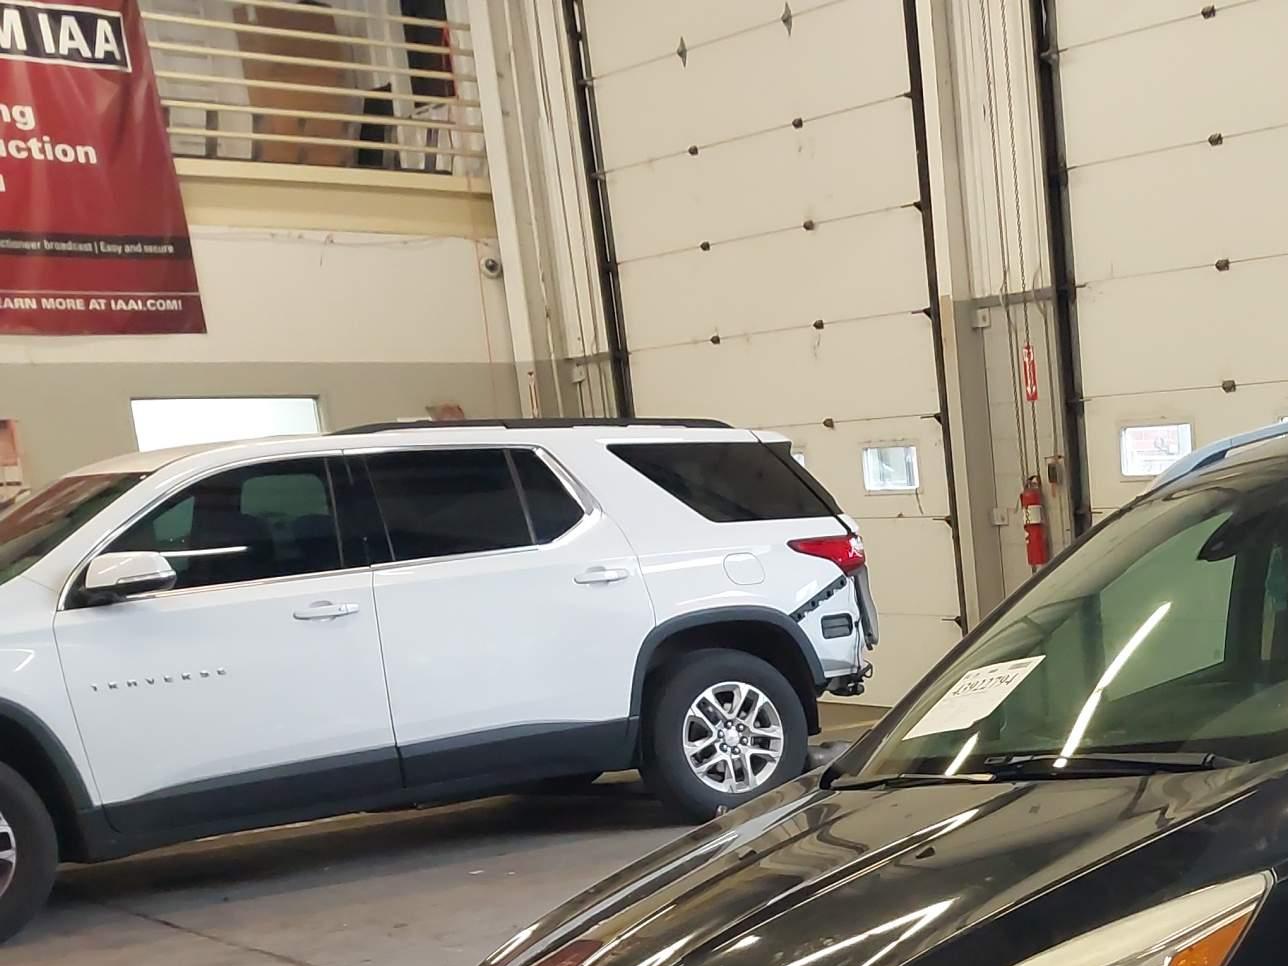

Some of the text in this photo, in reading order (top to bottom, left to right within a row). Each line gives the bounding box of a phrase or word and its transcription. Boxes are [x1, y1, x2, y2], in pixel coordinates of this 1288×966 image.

[37, 13, 121, 61] IAA
[124, 243, 142, 253] and
[0, 296, 38, 310] ARN
[41, 297, 86, 311] MORE
[89, 298, 107, 311] AT
